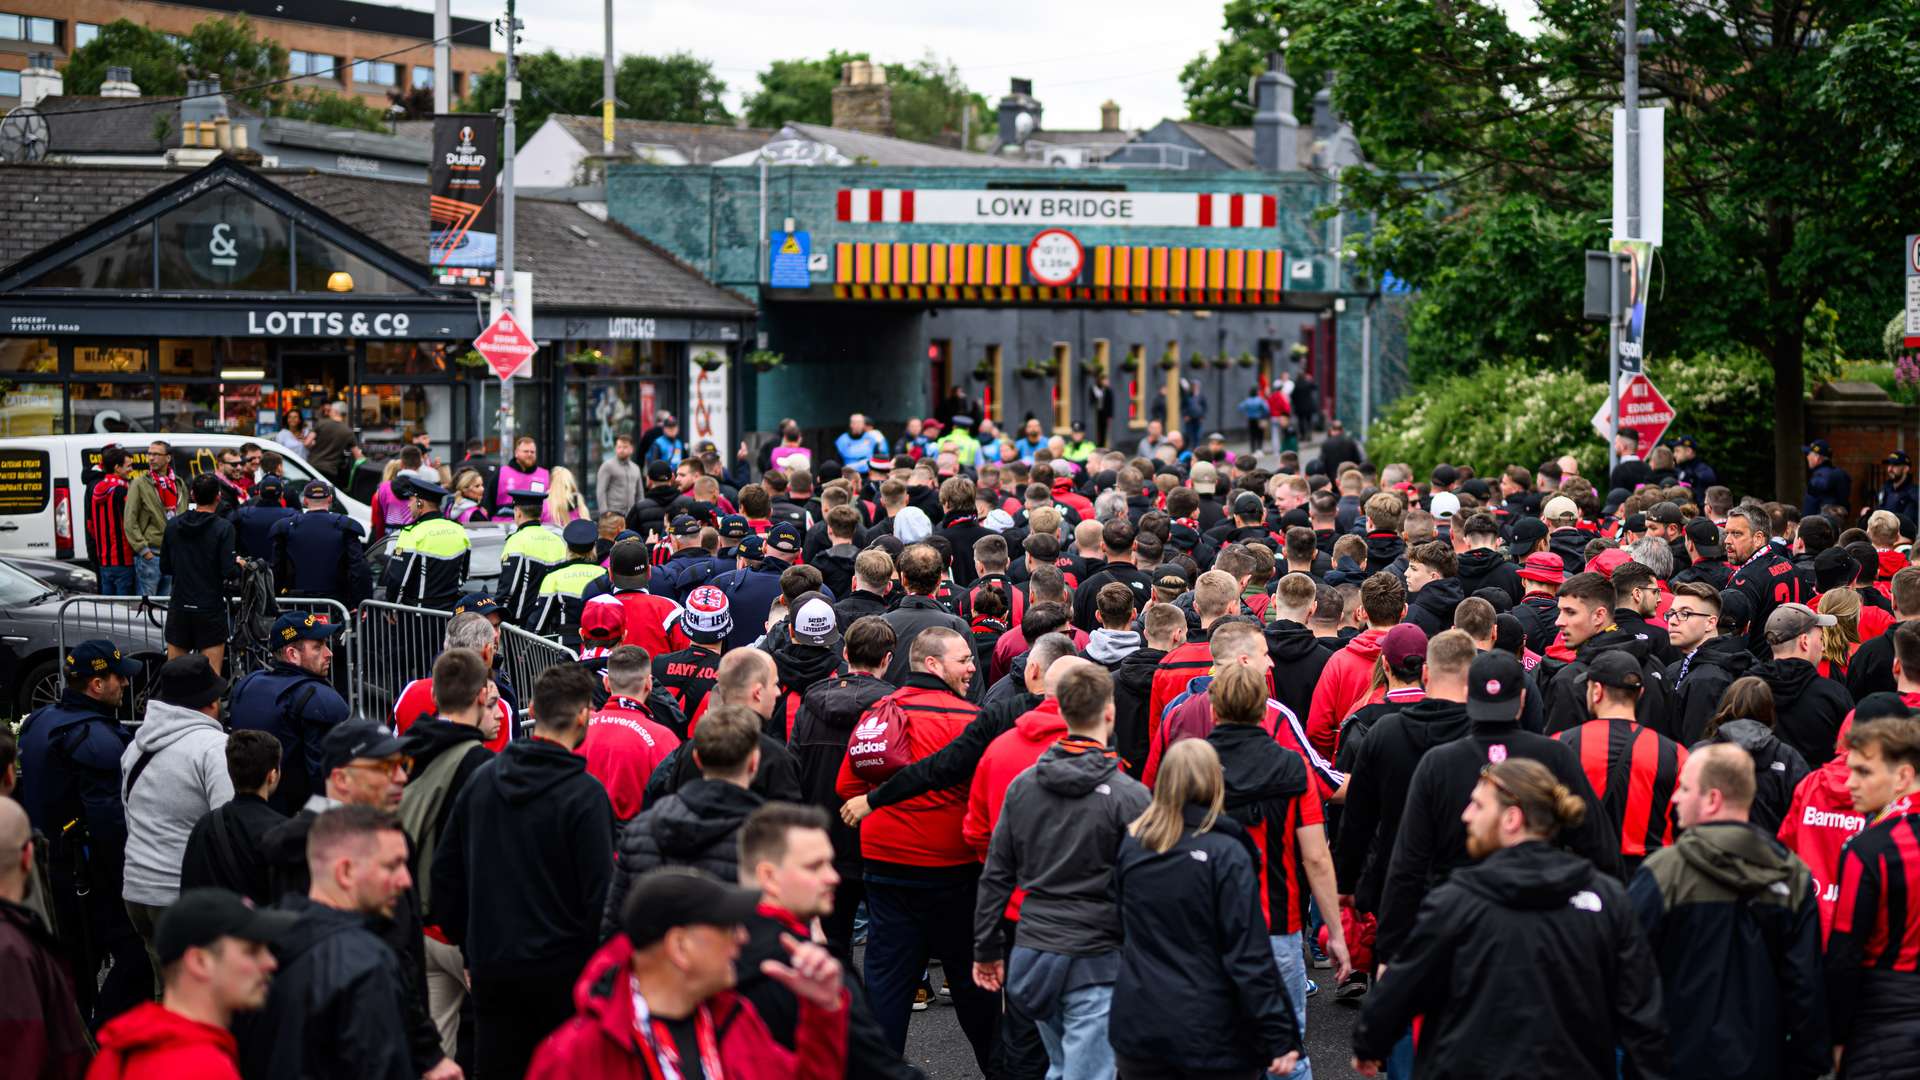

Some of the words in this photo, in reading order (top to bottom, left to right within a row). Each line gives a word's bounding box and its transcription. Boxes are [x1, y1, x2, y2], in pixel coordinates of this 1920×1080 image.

[977, 198, 1032, 216] LOW
[1041, 199, 1134, 218] BRIDGE
[249, 311, 344, 335] LOTTS
[600, 715, 656, 747] Leverkusen
[850, 741, 886, 756] adidas
[856, 757, 884, 768] ORIGINALS
[1803, 806, 1866, 831] Barmen
